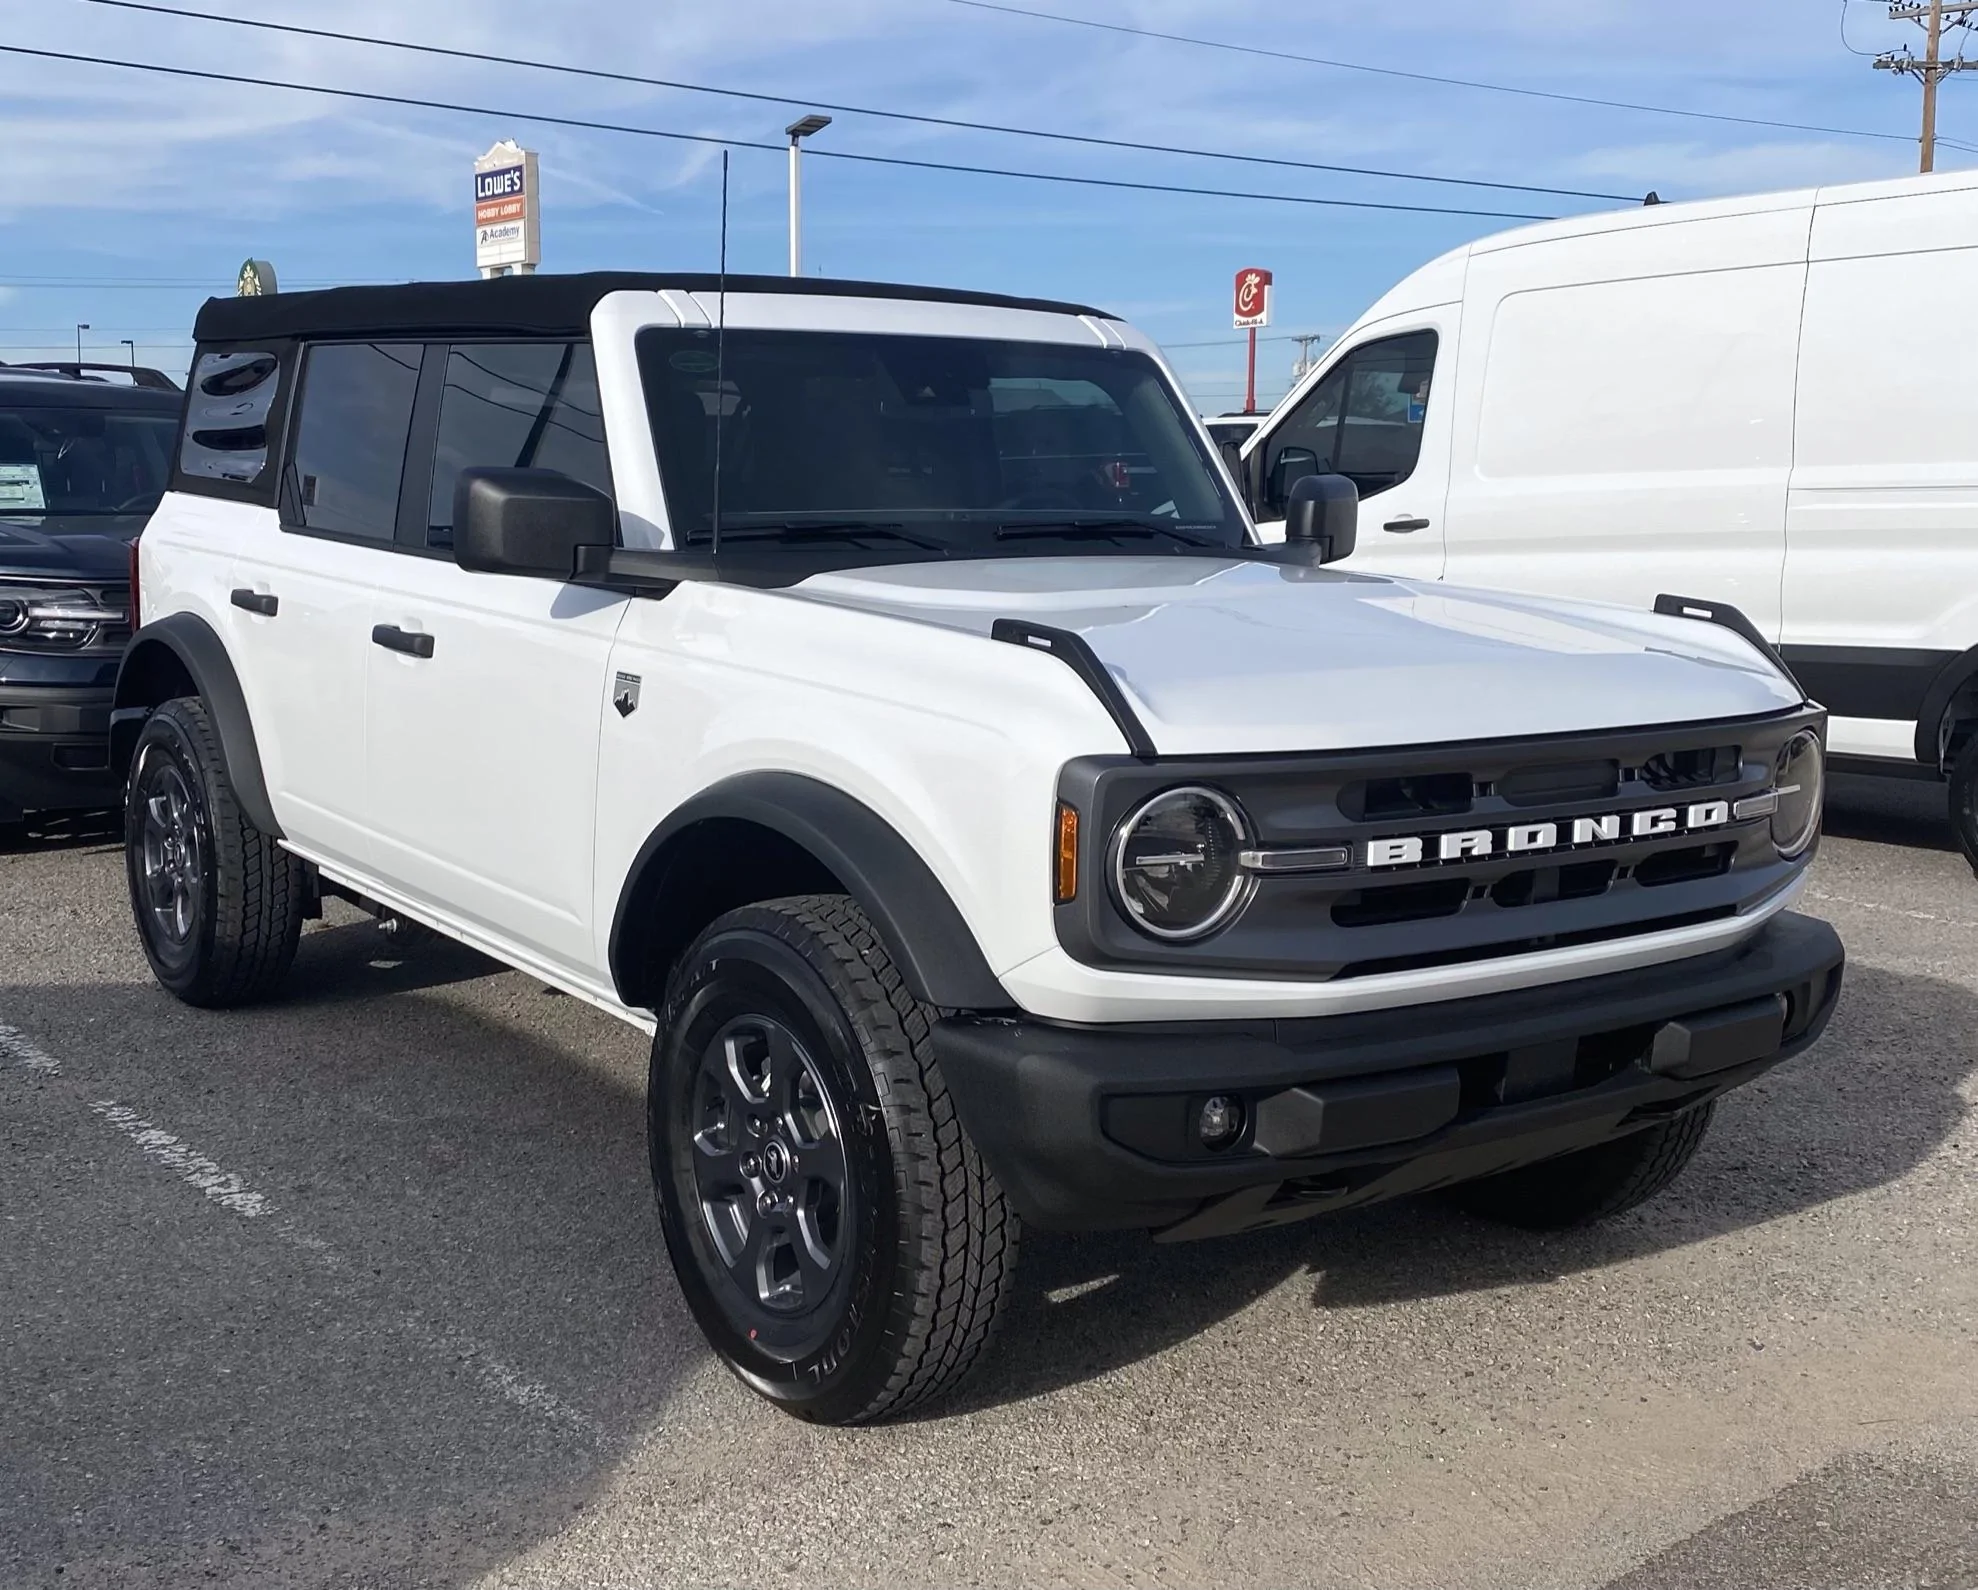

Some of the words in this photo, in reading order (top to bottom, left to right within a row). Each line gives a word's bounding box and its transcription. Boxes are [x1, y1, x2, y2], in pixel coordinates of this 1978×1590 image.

[477, 169, 521, 198] LOWE'S
[477, 206, 499, 220] HOBBY
[500, 202, 521, 216] LOBBY
[489, 226, 520, 240] Academy
[1367, 800, 1729, 867] BRONCO
